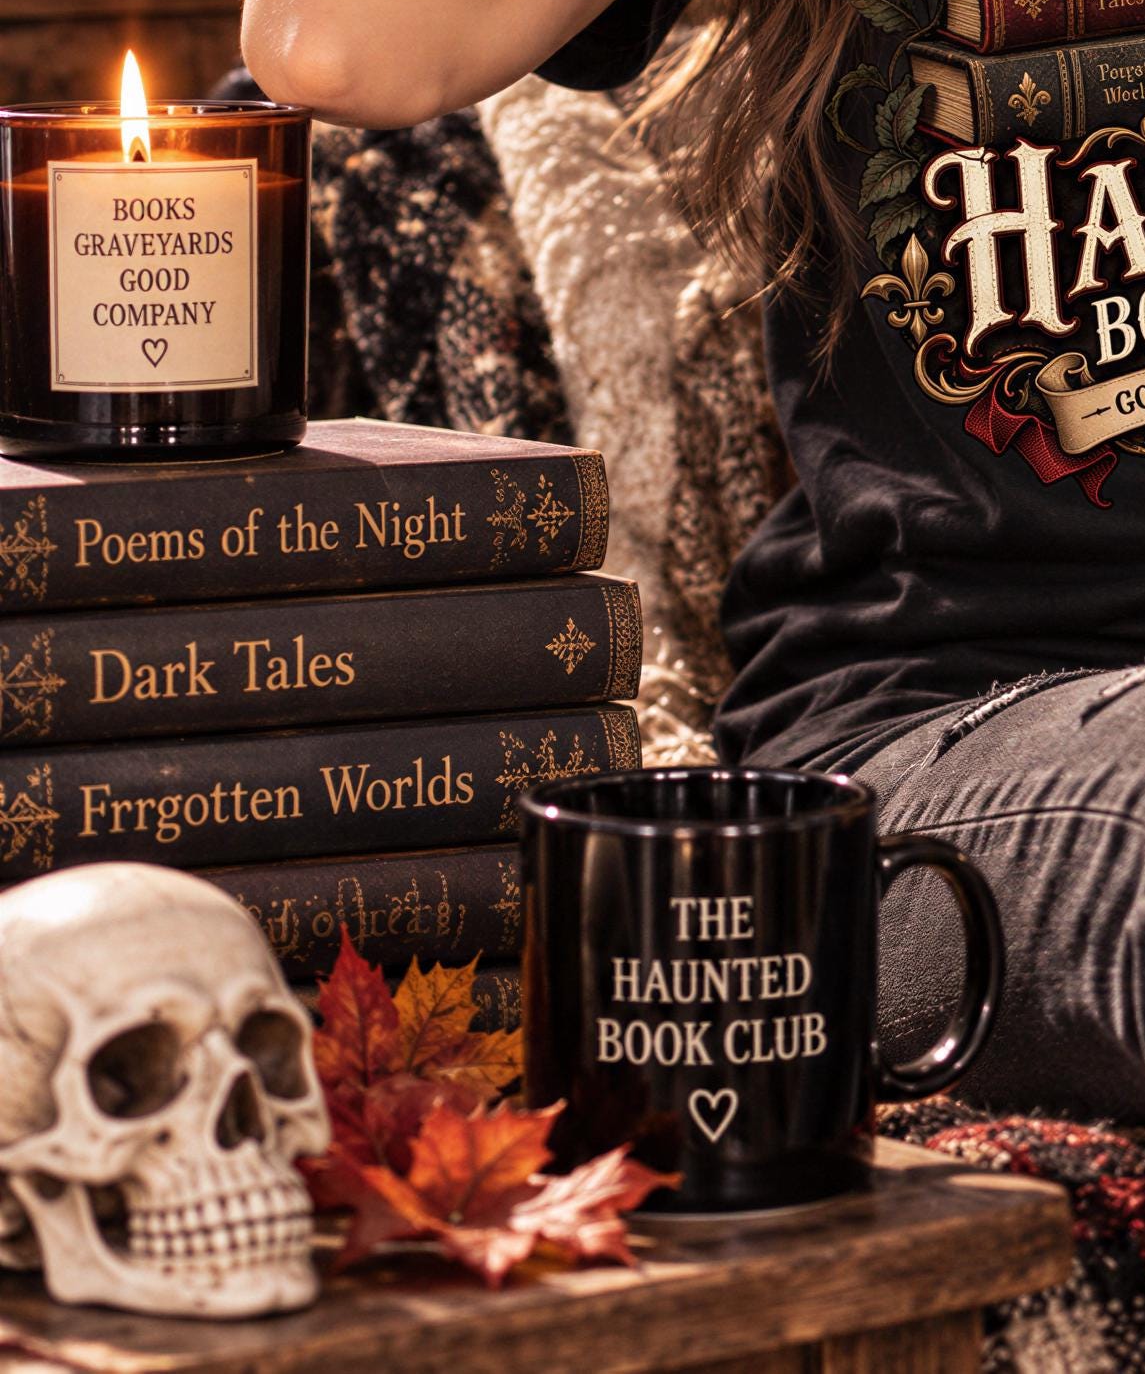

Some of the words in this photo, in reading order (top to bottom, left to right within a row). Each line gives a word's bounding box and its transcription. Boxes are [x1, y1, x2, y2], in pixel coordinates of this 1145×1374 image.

[113, 197, 195, 221] BOOKS
[74, 231, 233, 256] GRAVEYARDS
[120, 268, 189, 292] GOOD
[93, 301, 216, 326] COMPANY
[74, 517, 205, 568] Poems
[221, 507, 263, 557] of
[278, 504, 339, 554] the
[354, 495, 467, 560] Night
[89, 641, 218, 705] Dark
[234, 634, 355, 694] Tales
[78, 779, 303, 842] Frrgotten
[320, 755, 474, 816] Worlds
[671, 895, 754, 942] THE
[611, 953, 812, 1004] HAUNTED
[597, 1017, 713, 1065] BOOK
[724, 1013, 827, 1064] CLUB
